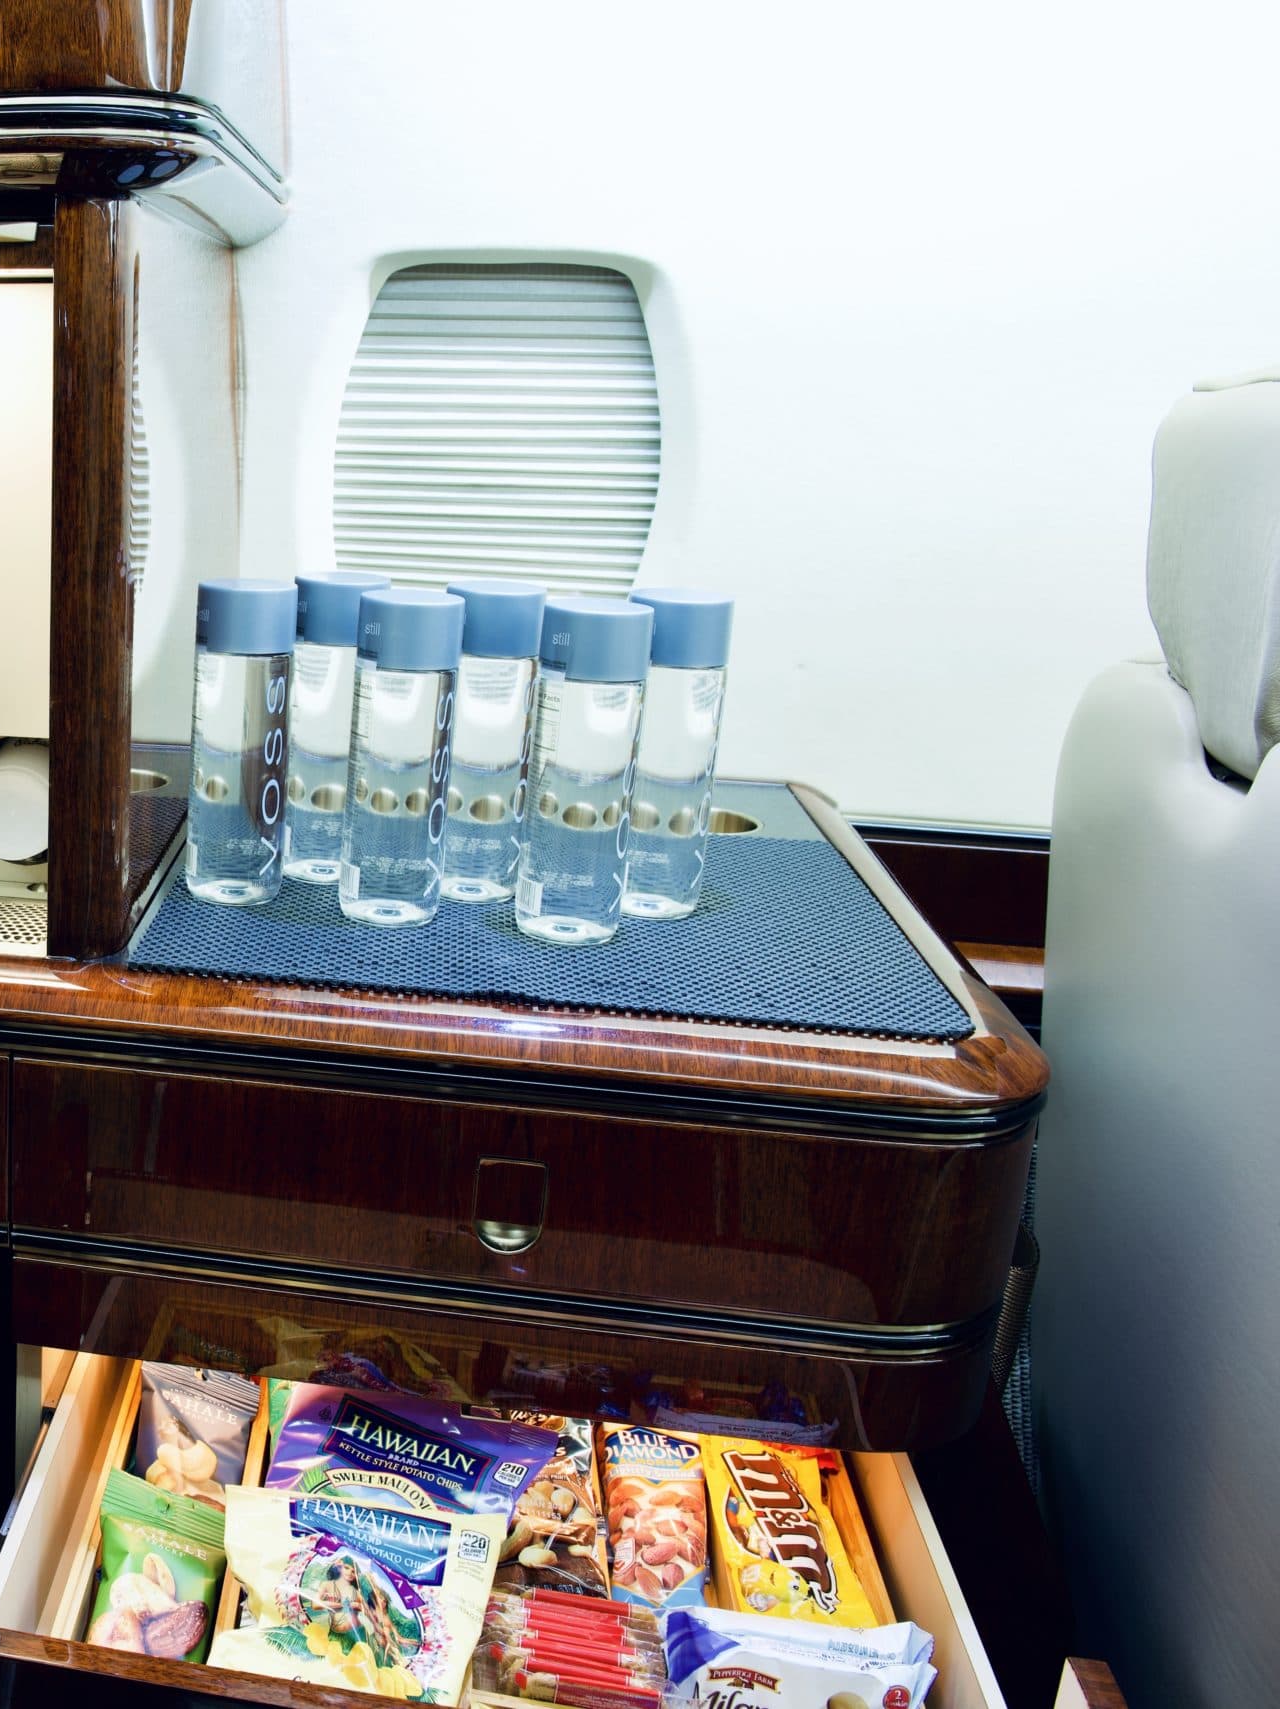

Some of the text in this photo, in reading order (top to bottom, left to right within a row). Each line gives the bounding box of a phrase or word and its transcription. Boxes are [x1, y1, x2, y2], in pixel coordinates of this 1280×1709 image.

[364, 622, 381, 636] still
[552, 632, 570, 647] still
[259, 676, 287, 877] VOSS
[423, 692, 454, 898] VOSS
[616, 1430, 672, 1449] BLUE
[338, 1441, 464, 1492] KETTLE STYLE POTATO CHIPS
[387, 1453, 420, 1467] BRAND
[501, 1463, 525, 1476] 210
[332, 1471, 375, 1484] SWEET
[377, 1475, 410, 1493] MAUI
[301, 1499, 439, 1551] HAWAIIAN
[348, 1529, 382, 1546] BRAND
[462, 1533, 487, 1549] 220
[366, 1544, 402, 1563] POTATO
[754, 1672, 774, 1686] FARM
[894, 1689, 902, 1700] 2
